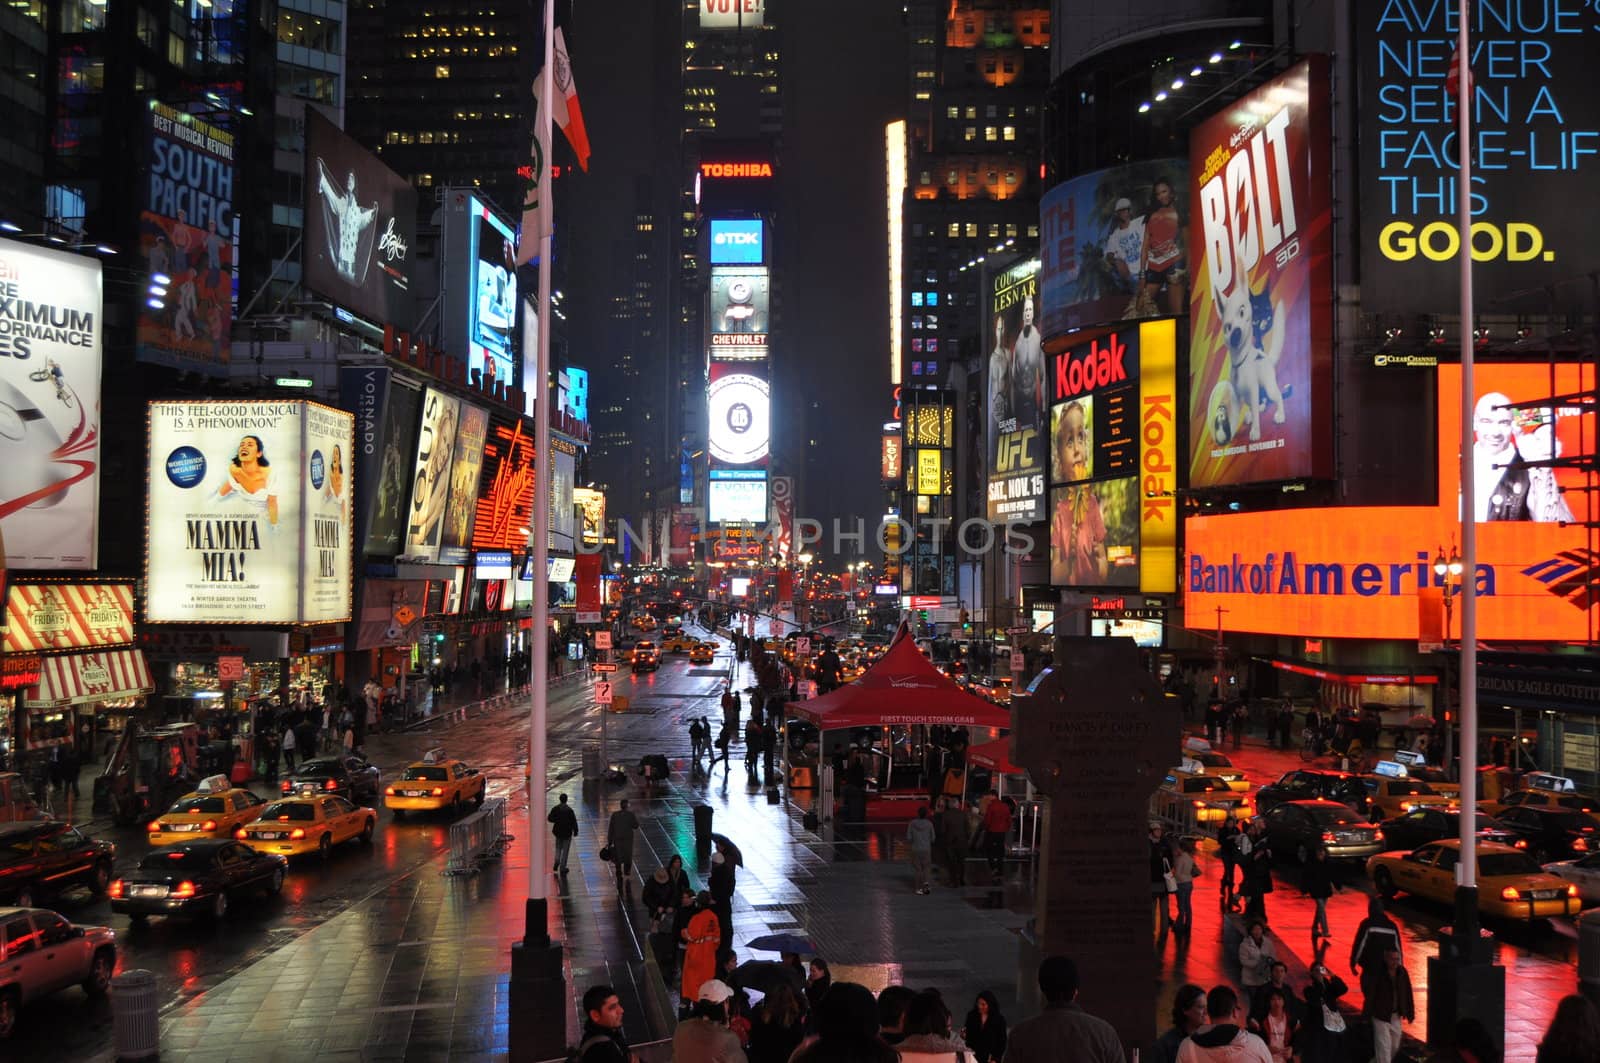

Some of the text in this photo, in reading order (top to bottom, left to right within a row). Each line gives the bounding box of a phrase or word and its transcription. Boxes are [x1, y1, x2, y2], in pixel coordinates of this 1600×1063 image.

[1526, 86, 1563, 124] A
[153, 114, 234, 160] BEST MUSICAL REVIVAL
[152, 137, 233, 201] SOUTH
[701, 163, 772, 177] TOSHIBA
[1199, 149, 1231, 187] TRAVOLTA
[1204, 144, 1223, 170] JOHN
[150, 173, 232, 237] PACIFIC
[1200, 107, 1297, 300] BOLT
[1379, 176, 1488, 215] THIS
[726, 232, 759, 244] TDK
[1275, 237, 1300, 269] 3D
[1379, 221, 1555, 262] GOOD.
[994, 280, 1036, 312] LESNAR
[712, 334, 766, 345] CHEVROLET
[1056, 332, 1127, 399] Kodak
[173, 417, 184, 429] IS
[184, 418, 195, 428] A
[187, 404, 248, 417] FEEL-GOOD
[251, 403, 298, 416] MUSICAL
[365, 371, 376, 455] VORNADO
[923, 457, 935, 465] THE
[997, 429, 1038, 472] UFC
[1143, 394, 1172, 523] Kodak
[921, 466, 938, 477] LION
[921, 477, 938, 488] KING
[1008, 477, 1030, 499] NOV.
[1030, 475, 1044, 496] 15
[186, 520, 262, 550] MAMMA
[314, 519, 340, 548] MAMMA
[201, 551, 246, 582] MIA!
[319, 549, 335, 577] MIA!
[1190, 552, 1246, 594] Bank
[1249, 552, 1275, 595] of
[1517, 680, 1552, 696] EAGLE
